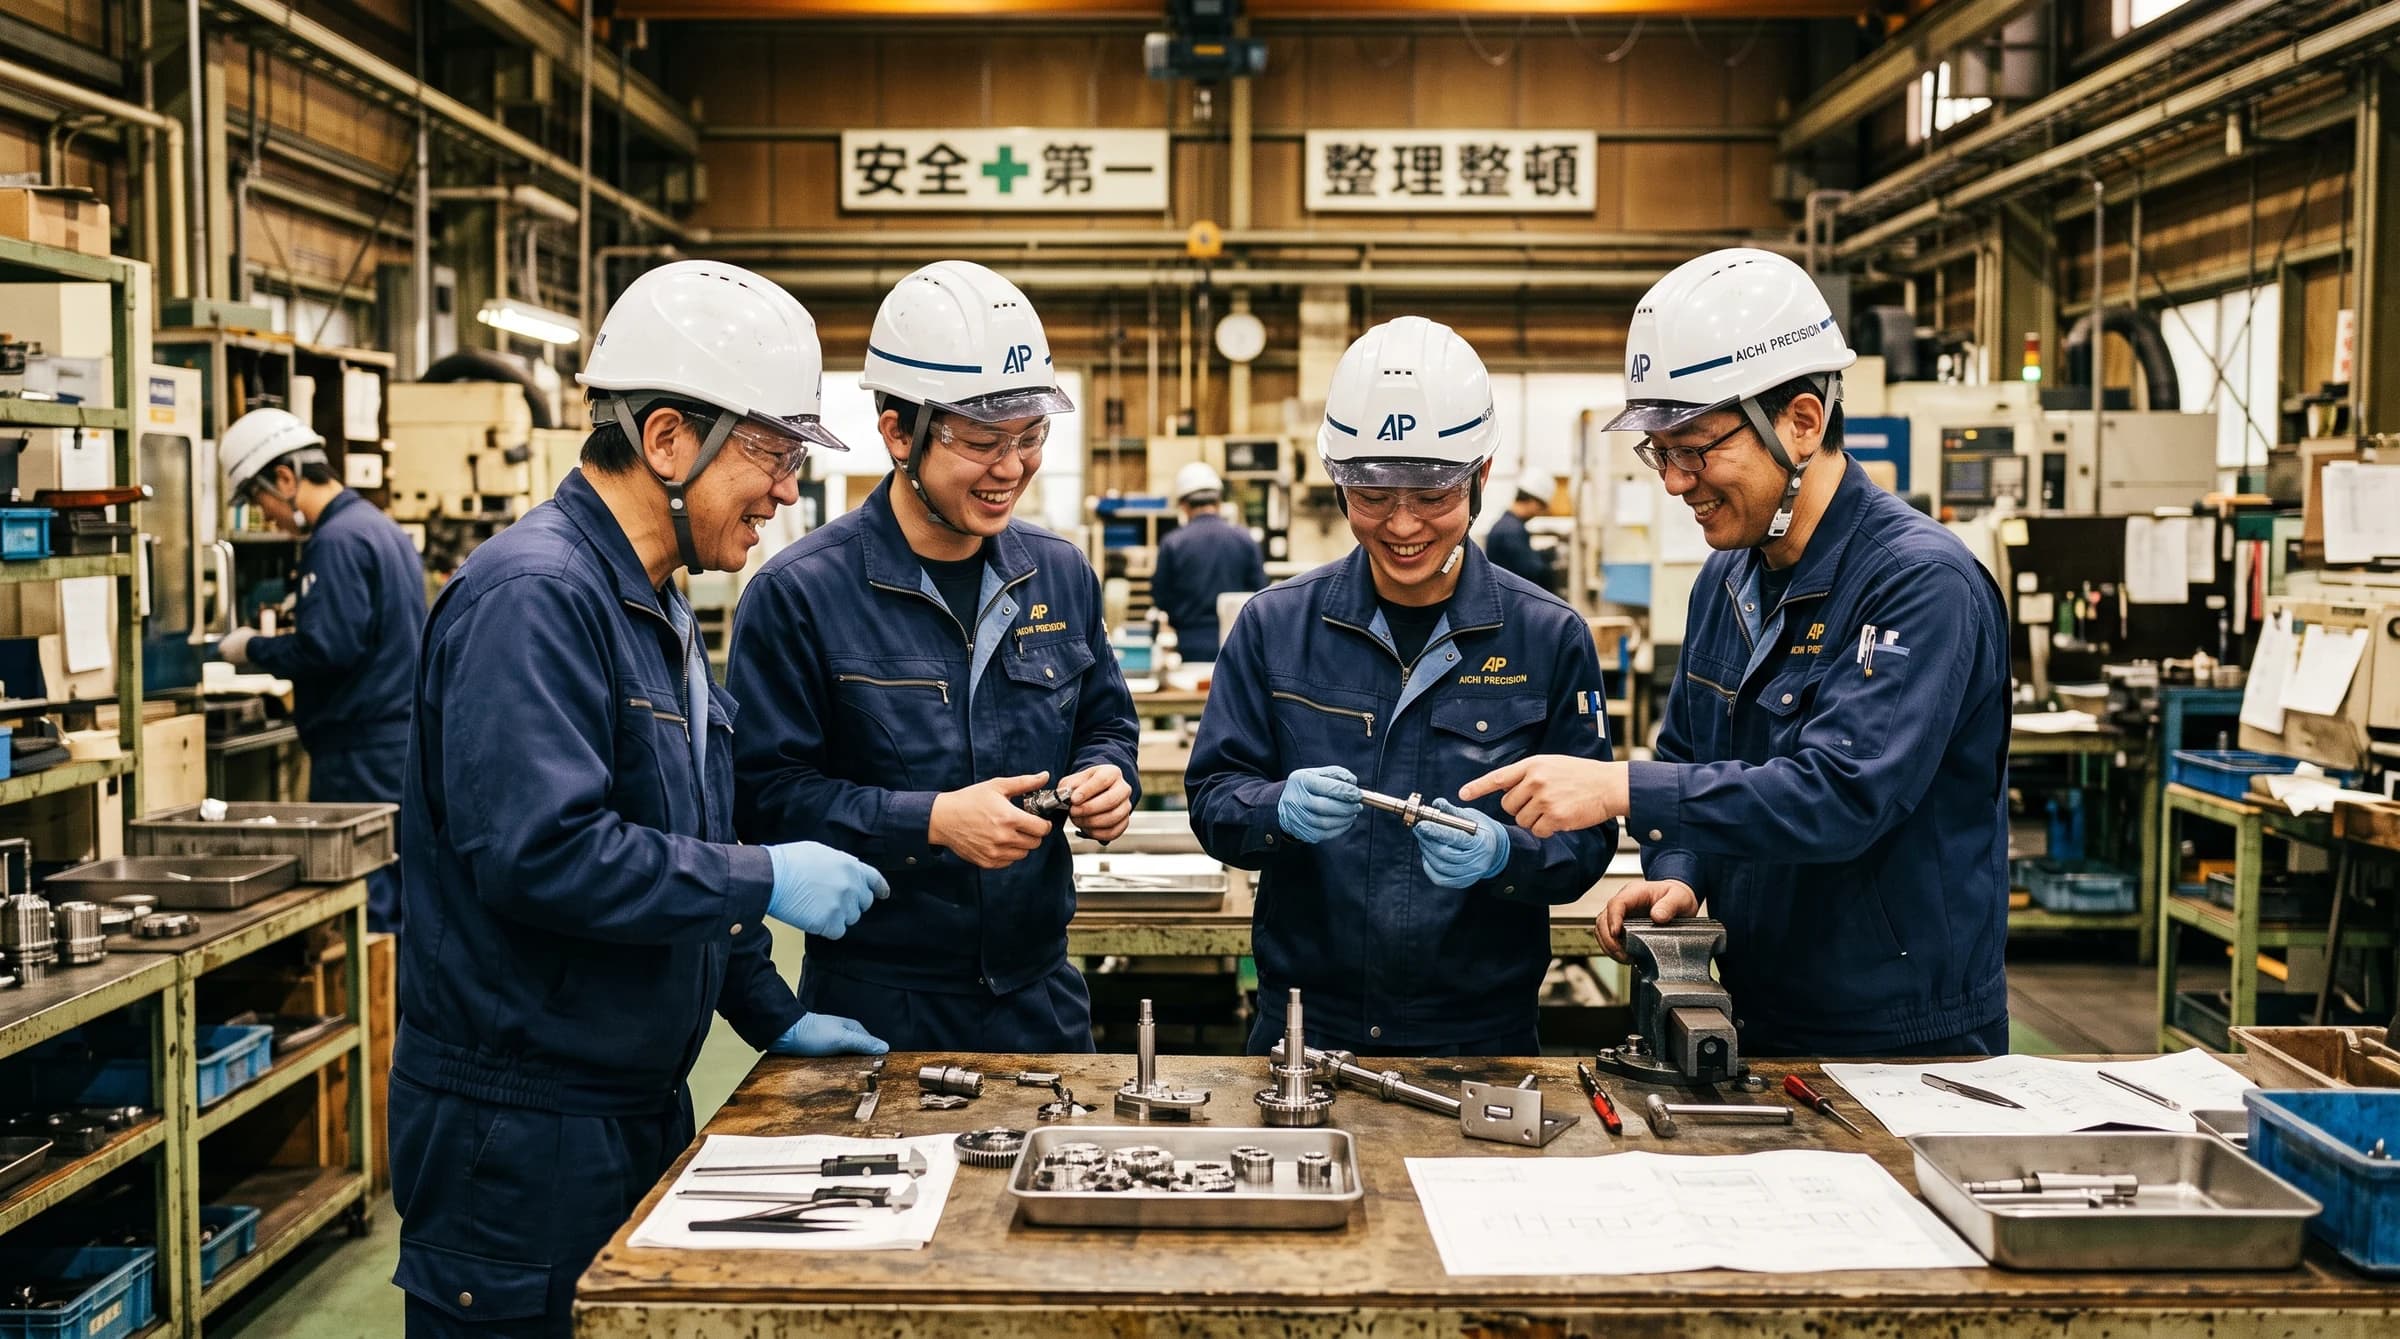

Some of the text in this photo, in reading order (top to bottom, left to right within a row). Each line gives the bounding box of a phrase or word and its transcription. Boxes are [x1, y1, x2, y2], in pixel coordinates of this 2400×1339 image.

[1325, 144, 1578, 196] 整理整頓
[1736, 323, 1821, 362] AICHI PRECISION
[1003, 344, 1032, 374] AP
[1631, 353, 1651, 383] AP
[1376, 413, 1416, 441] AP
[1030, 604, 1048, 620] AP
[1806, 623, 1825, 640] AP
[1480, 656, 1507, 672] AP
[1458, 674, 1527, 685] AICHI PRECISION
